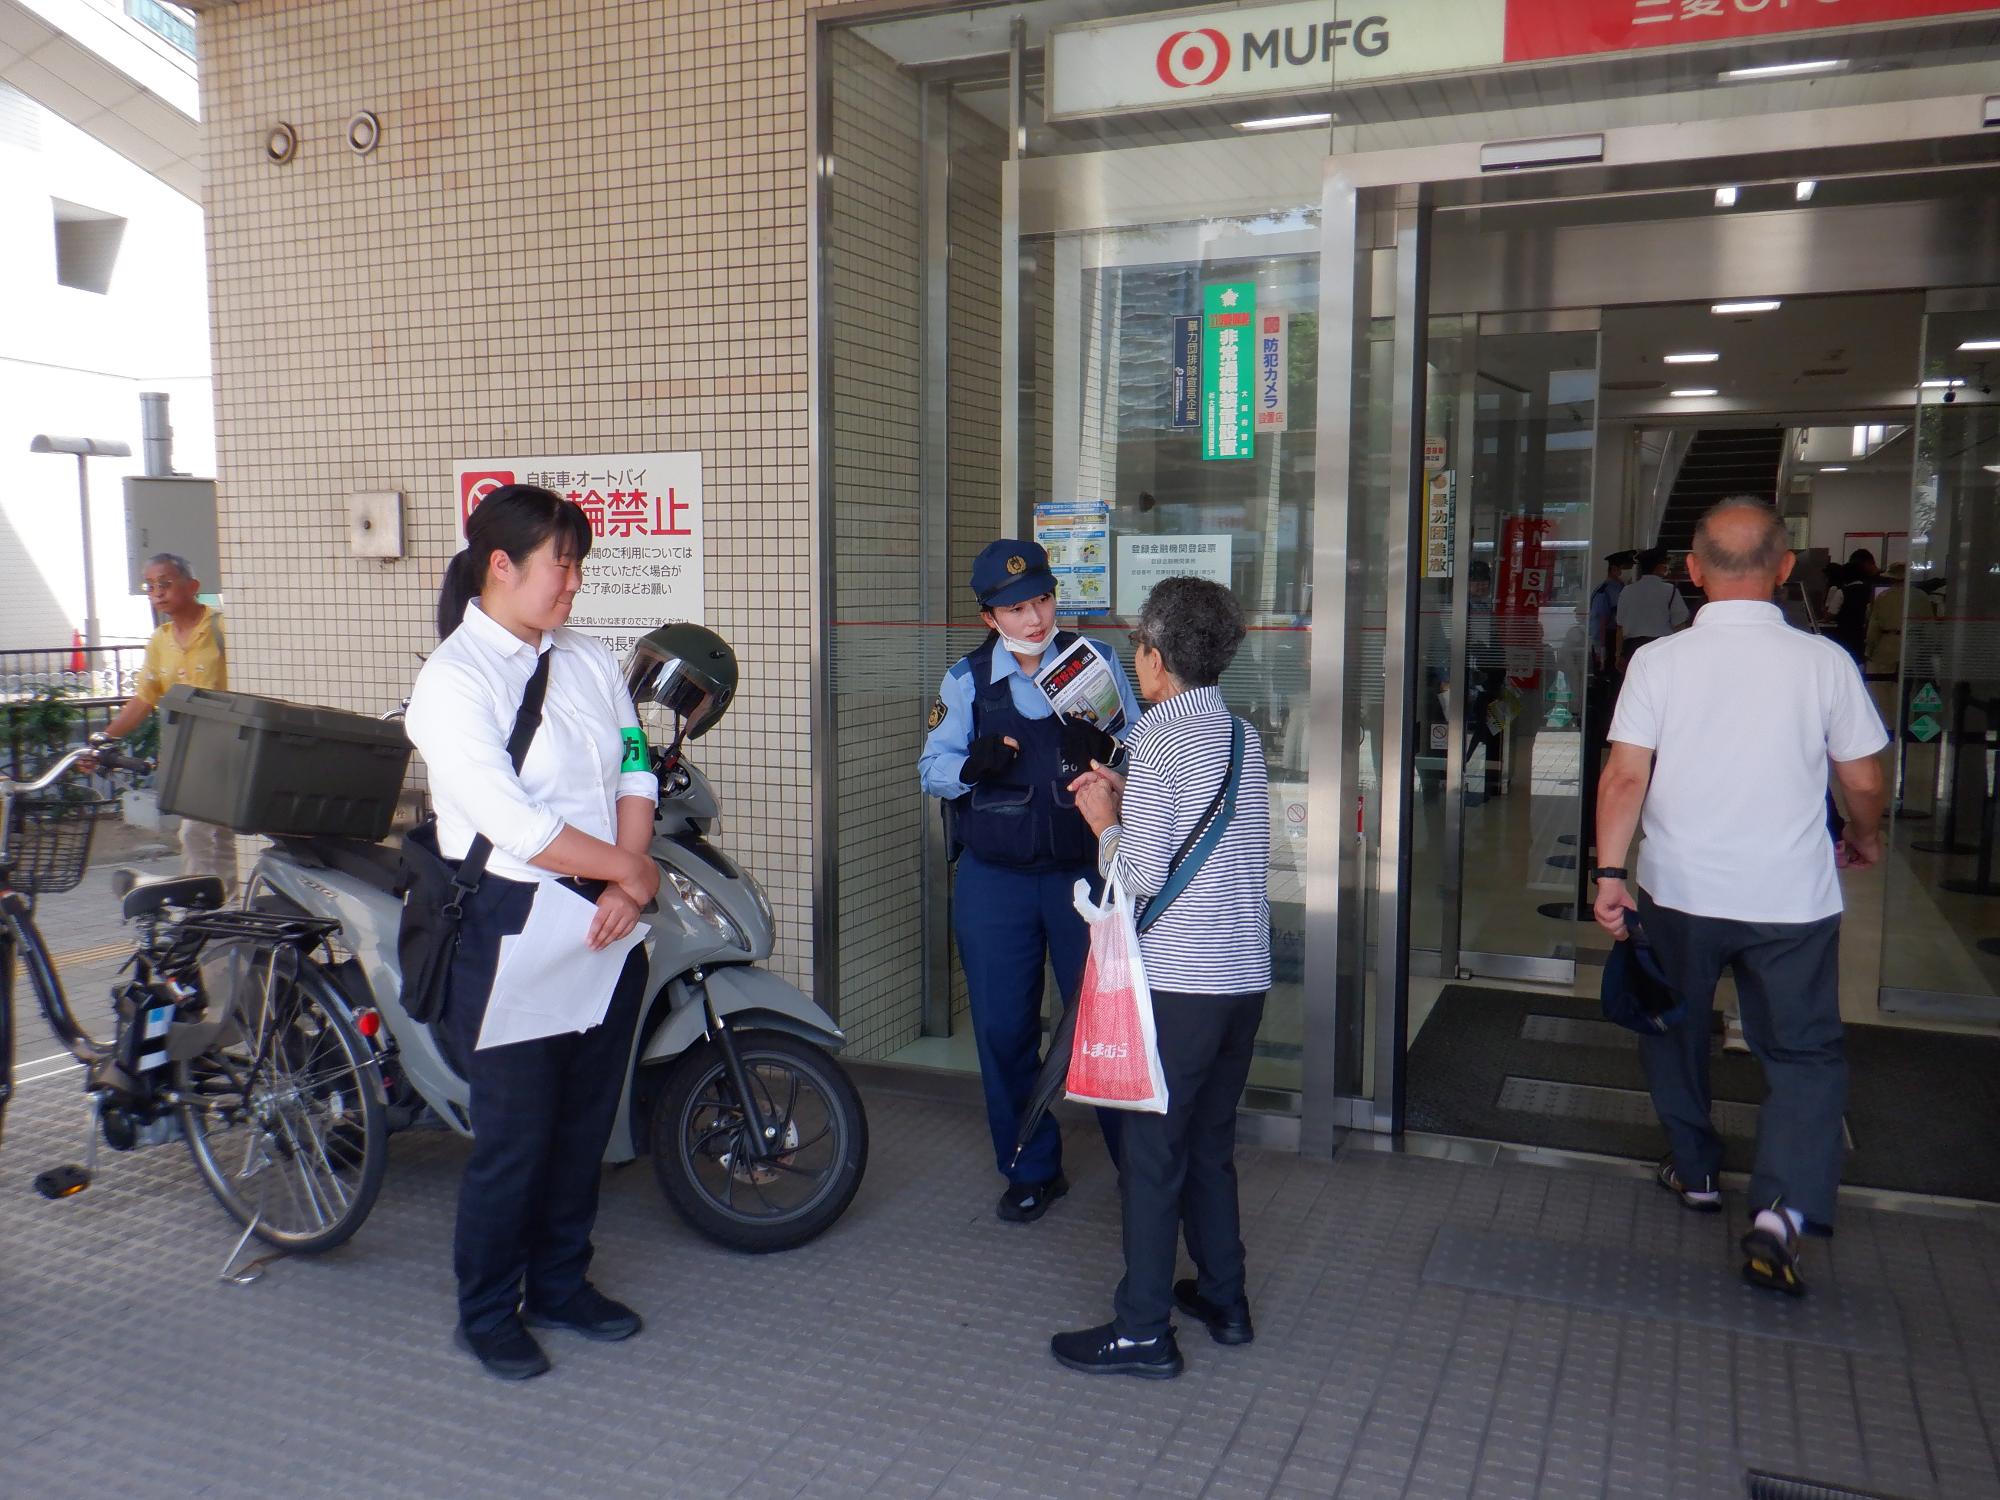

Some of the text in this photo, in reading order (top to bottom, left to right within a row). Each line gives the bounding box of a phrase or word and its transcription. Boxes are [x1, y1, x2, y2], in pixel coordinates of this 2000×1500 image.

[1242, 17, 1390, 72] MUFG
[1263, 337, 1279, 409] 防犯カメラ
[527, 469, 647, 488] 自転車・オートバイ
[566, 487, 692, 538] 輪禁止
[1082, 1040, 1128, 1058] しまむら
